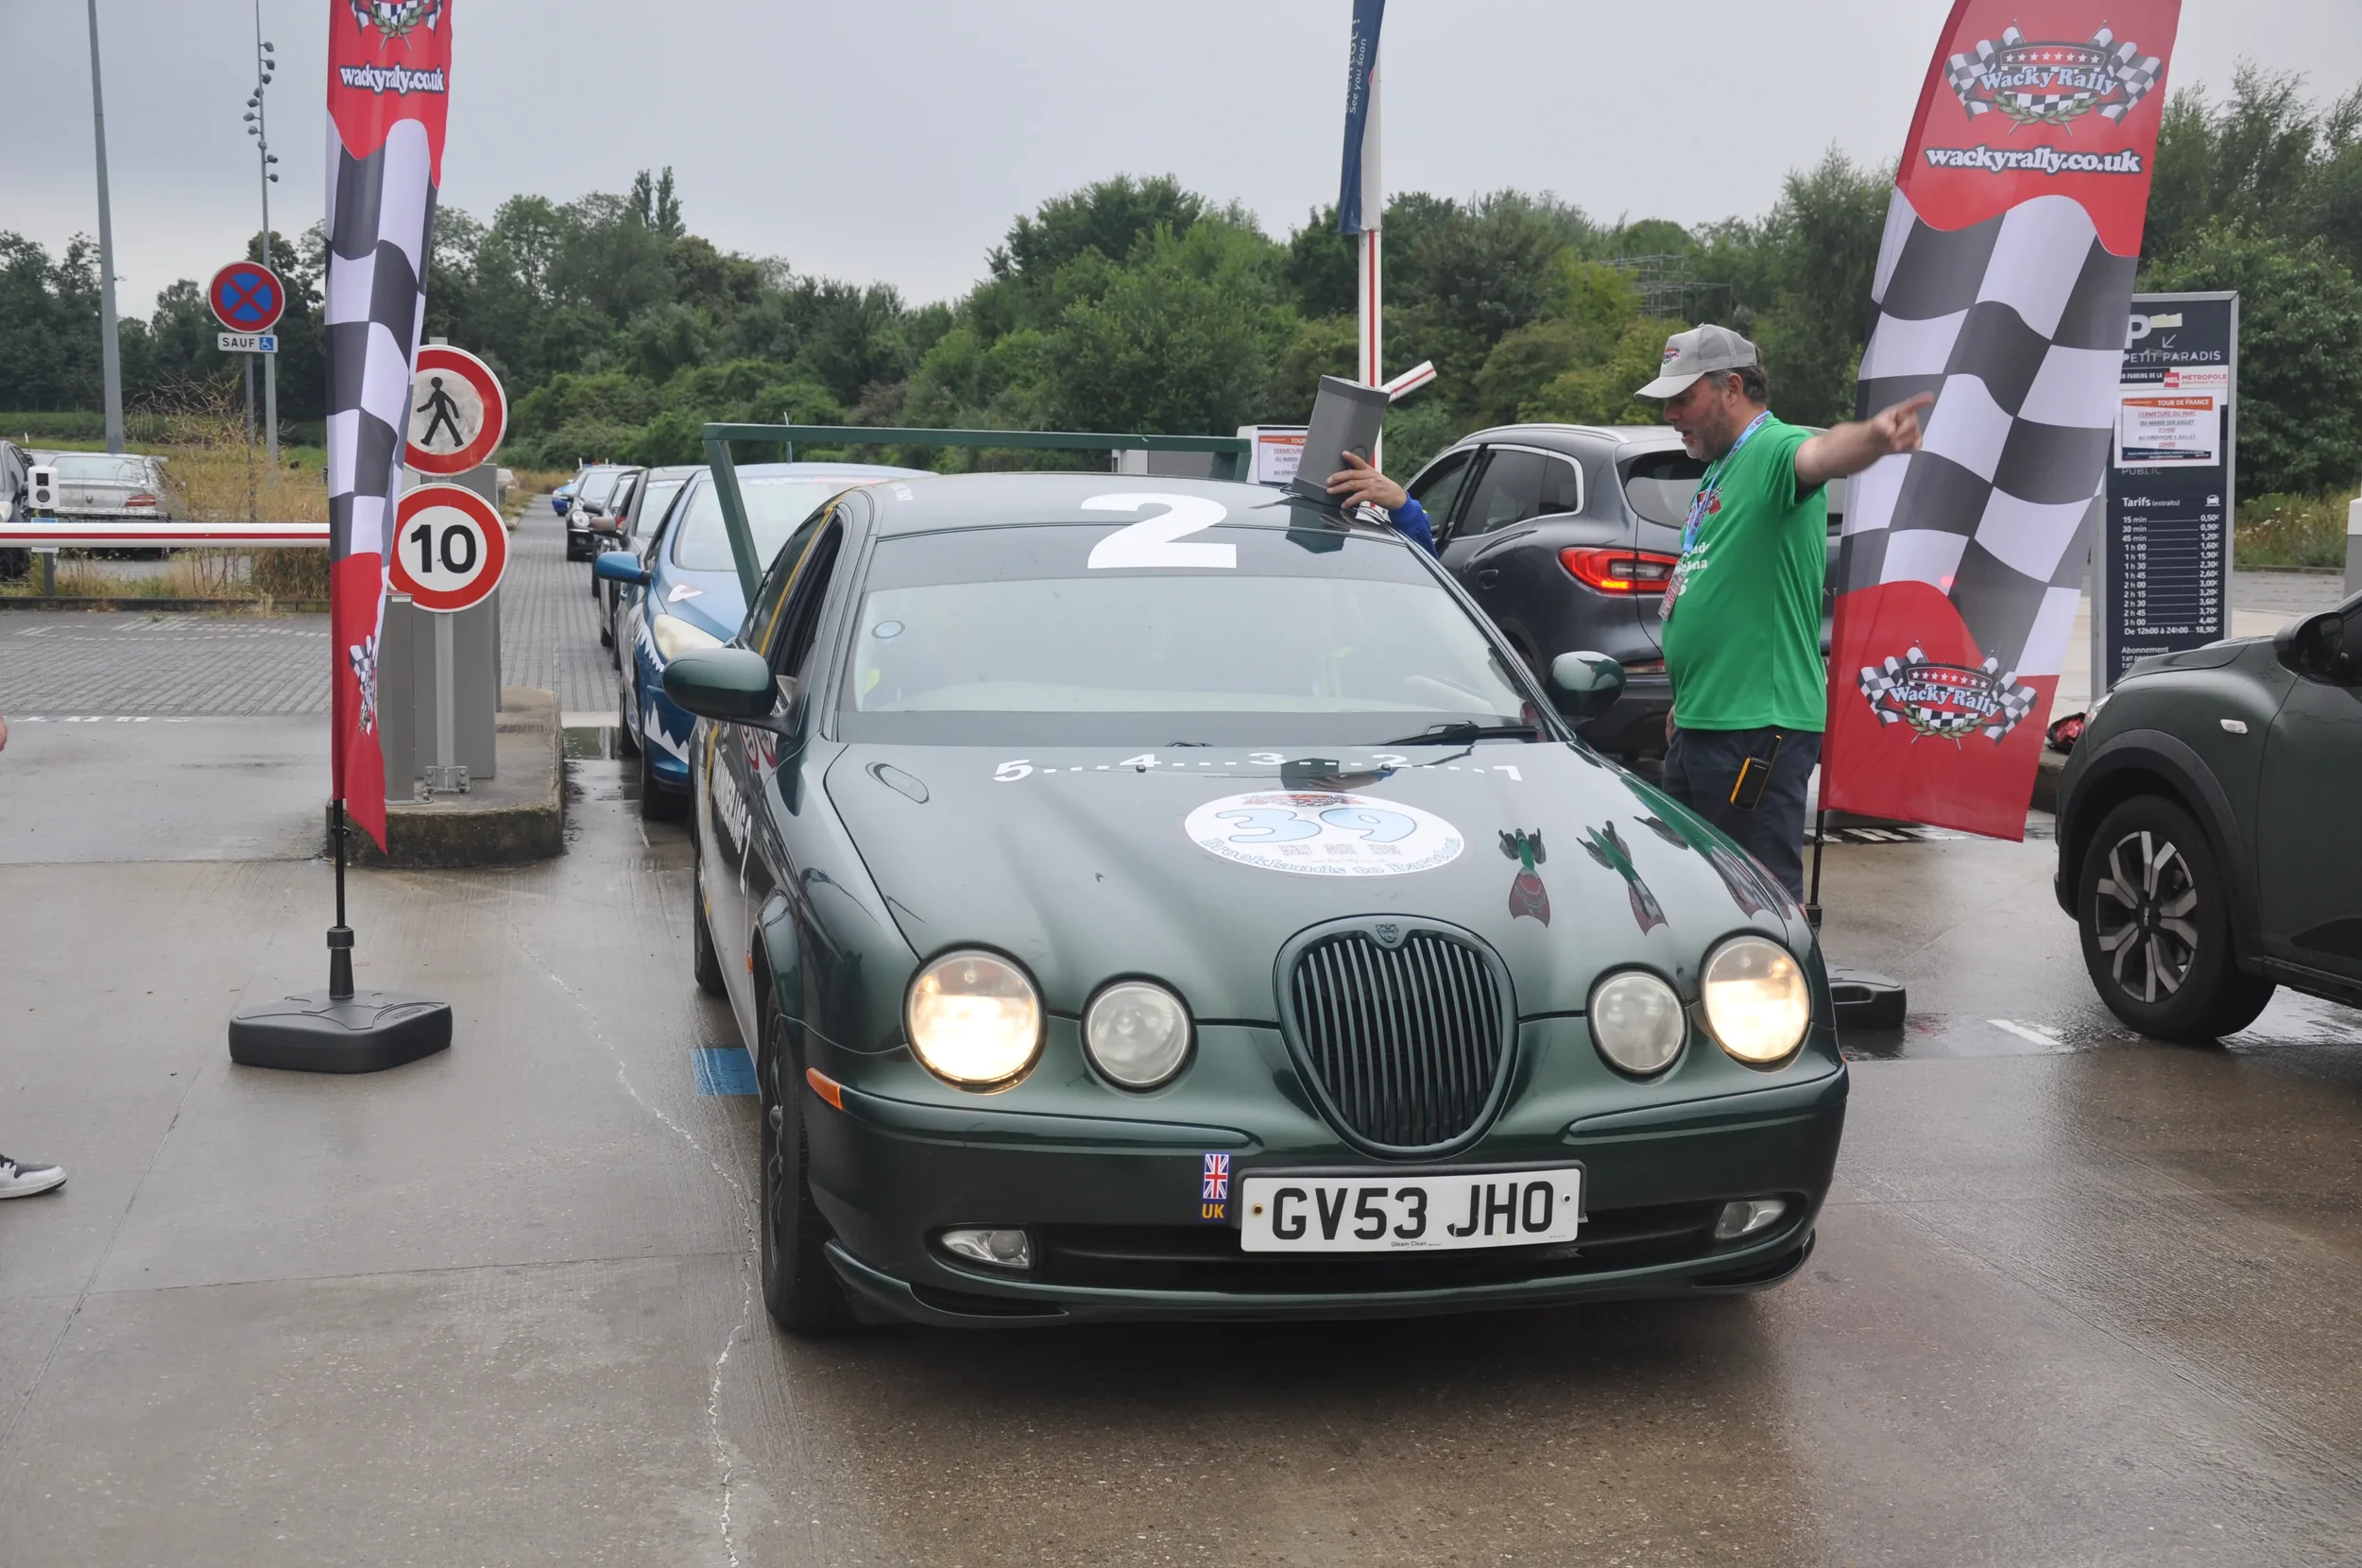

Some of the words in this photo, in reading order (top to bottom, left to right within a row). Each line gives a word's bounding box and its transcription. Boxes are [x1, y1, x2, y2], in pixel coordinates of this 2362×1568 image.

[340, 62, 445, 94] wackyrally.co.uk
[1349, 93, 1359, 113] See
[1354, 69, 1362, 90] you
[1358, 38, 1367, 66] soon
[1980, 67, 2057, 91] Wacky
[2057, 68, 2119, 95] Rally
[1926, 145, 2141, 174] wackyrally.co.uk
[222, 337, 255, 348] SAUF
[2124, 314, 2152, 349] P
[2122, 352, 2158, 363] PETIT
[2162, 350, 2221, 362] PARADIS
[2122, 467, 2162, 475] PUBLIC
[2122, 497, 2151, 507] Tarifs
[2152, 499, 2180, 507] (extraits)
[1081, 493, 1237, 569] 2
[411, 524, 476, 573] 10
[2121, 646, 2169, 655] Abonnement
[1889, 685, 1951, 706] Wacky
[1952, 689, 2000, 717] Rally
[993, 759, 1034, 782] 5
[1120, 754, 1162, 768] 4
[1248, 753, 1287, 765] 3
[1372, 754, 1412, 768] 2
[1493, 765, 1523, 782] 1
[1215, 808, 1417, 844] 39
[1201, 838, 1347, 875] Brooklands
[1353, 866, 1385, 875] to
[1202, 1203, 1225, 1219] UK
[1272, 1186, 1428, 1241] GV53
[1446, 1180, 1554, 1238] JHO
